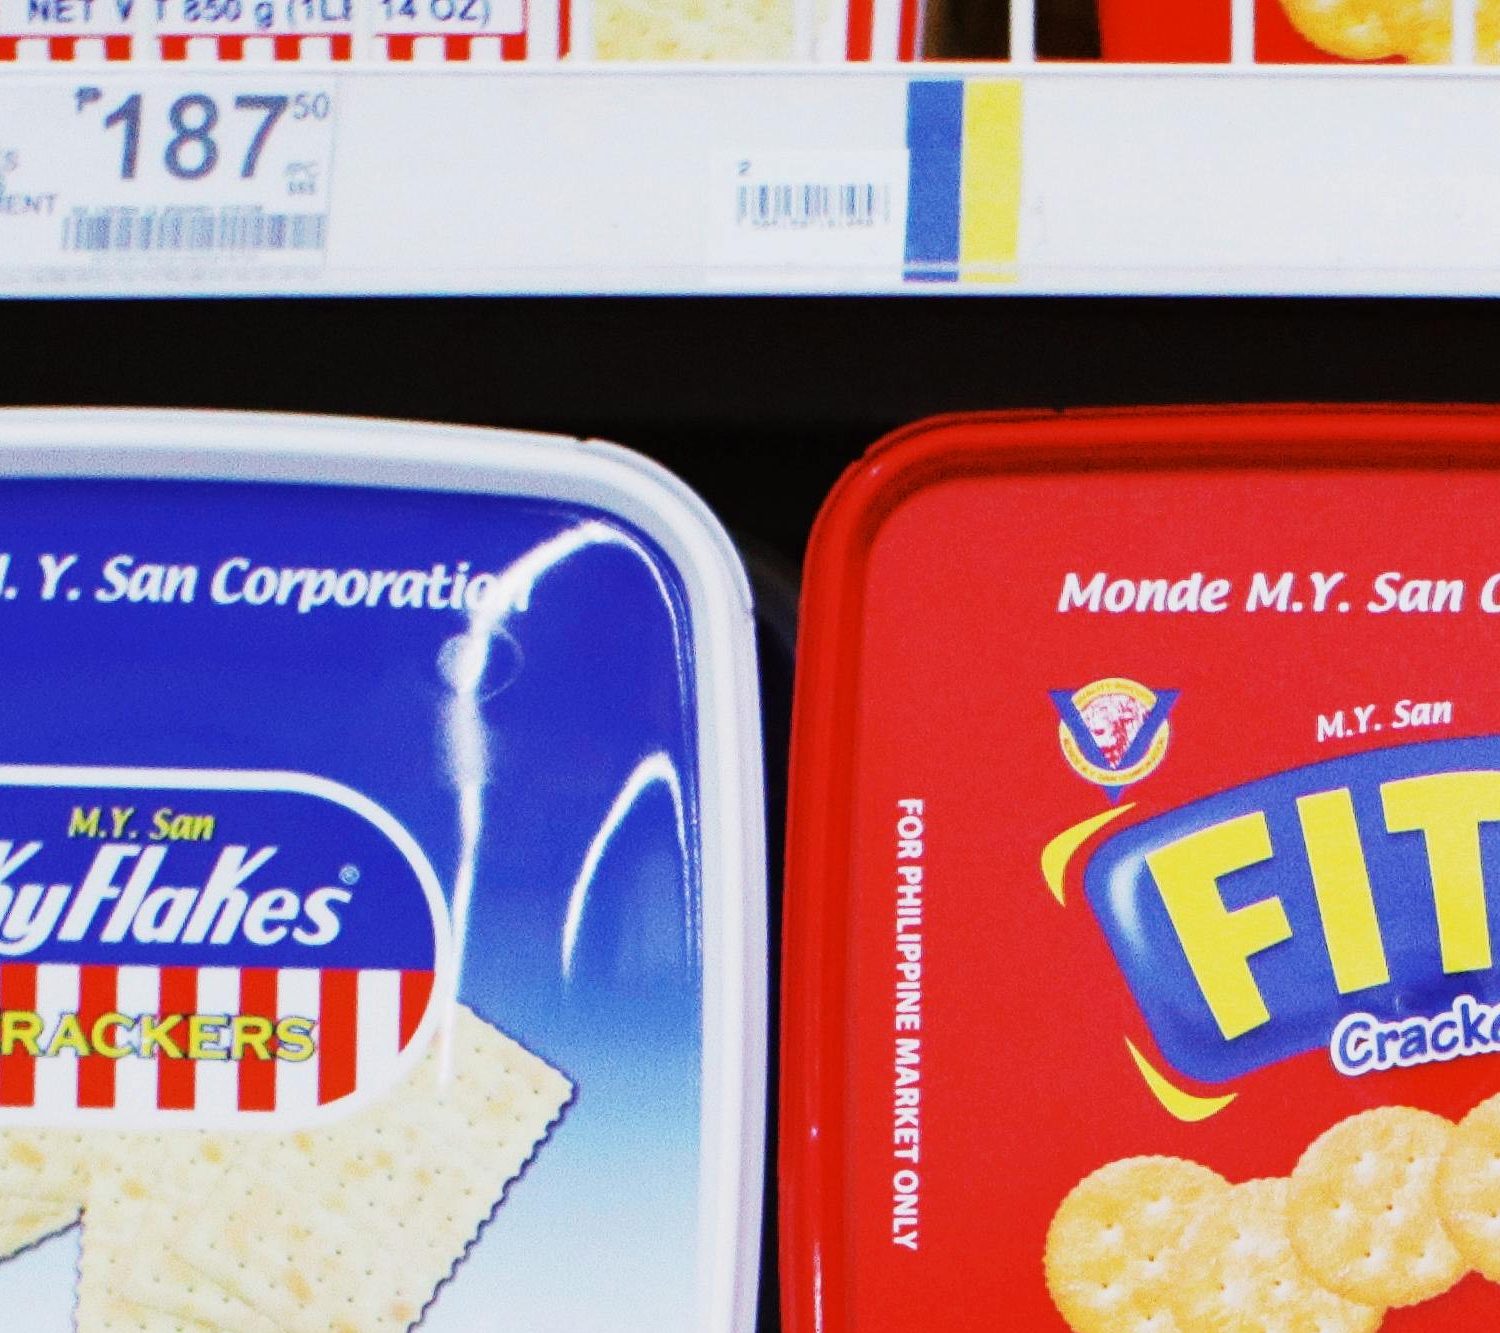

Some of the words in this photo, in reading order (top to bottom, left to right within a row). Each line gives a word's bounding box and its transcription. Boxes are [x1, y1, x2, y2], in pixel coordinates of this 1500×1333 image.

[293, 93, 330, 119] 50
[37, 553, 83, 602] Y.
[95, 553, 199, 605] San
[211, 555, 531, 614] Corporation
[1058, 572, 1231, 613] Monde
[1244, 571, 1354, 615] M.Y.
[1367, 572, 1464, 613] San
[67, 806, 141, 842] M.Y.
[151, 806, 216, 844] San
